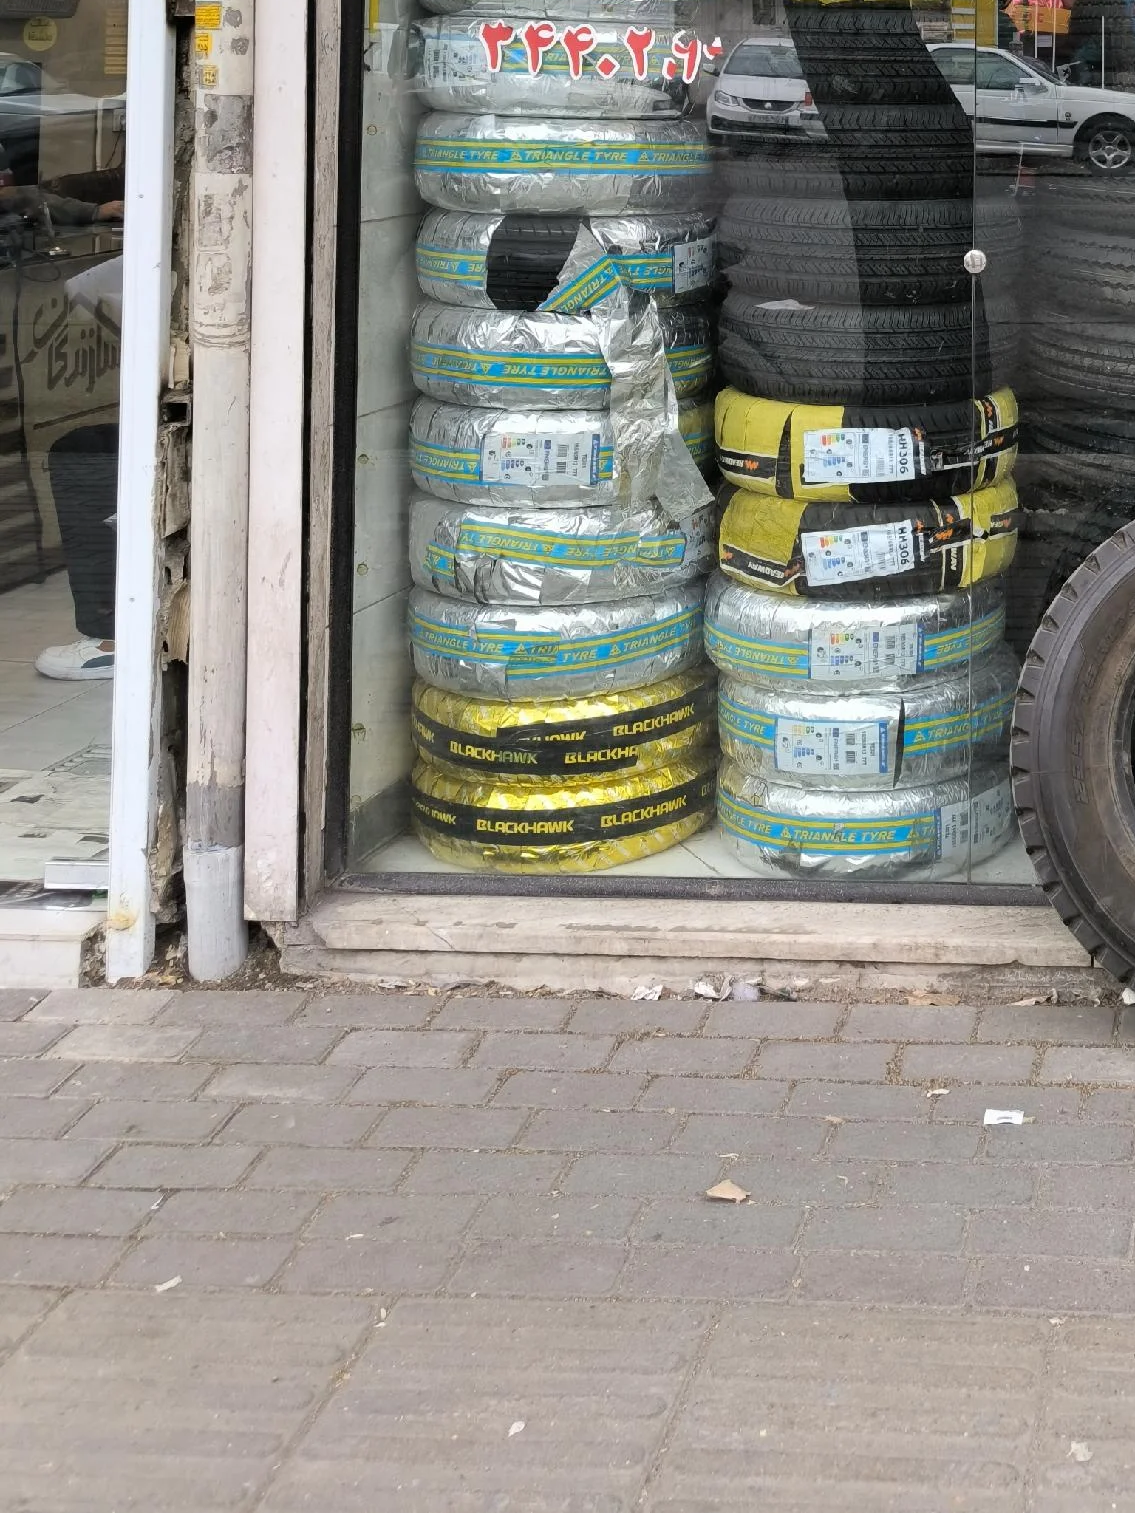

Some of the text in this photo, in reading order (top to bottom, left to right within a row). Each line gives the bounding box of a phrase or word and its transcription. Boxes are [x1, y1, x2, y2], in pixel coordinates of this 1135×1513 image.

[471, 150, 499, 161] TYRE
[525, 151, 628, 161] TRIANGLE TYRE
[503, 364, 606, 377] TRIANGLE TYRE
[425, 630, 504, 654] TRIANGLE TYRE
[623, 627, 677, 651] TRIANGLE
[562, 648, 597, 663] TYRE
[734, 646, 785, 665] TRIANGLE
[612, 702, 695, 737] BLACKHAWK
[743, 720, 767, 735] TYRE
[449, 739, 538, 765] BLACKHAWK
[564, 744, 638, 764] BLACKHA
[600, 794, 687, 829] BLACKHAWK
[476, 819, 574, 835] BLACKHAWK
[750, 820, 771, 835] TYRE
[793, 829, 897, 843] TRIANGLE TYRE
